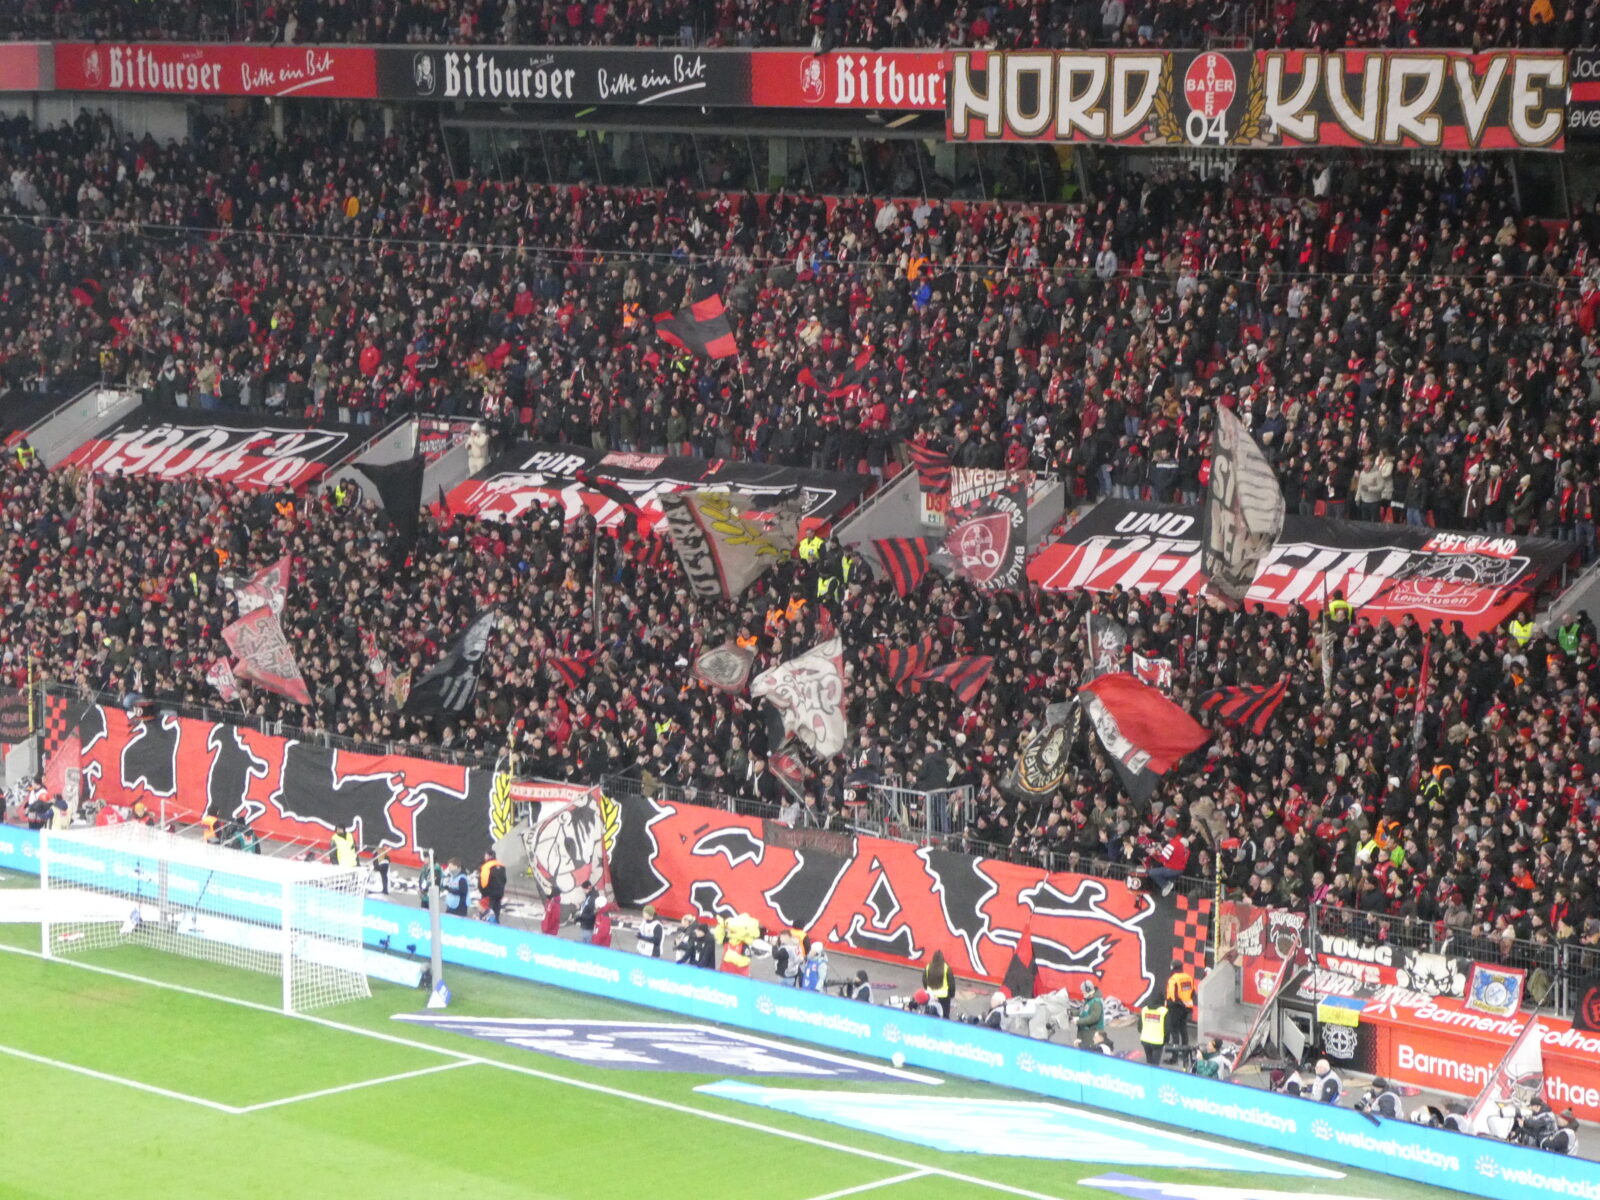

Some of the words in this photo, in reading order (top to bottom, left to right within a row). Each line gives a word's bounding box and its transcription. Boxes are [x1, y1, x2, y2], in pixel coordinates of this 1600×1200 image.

[108, 46, 222, 92] Bitburger
[240, 61, 274, 92] Bitte
[278, 62, 304, 82] ein
[443, 50, 576, 100] Bitburger
[597, 67, 637, 100] Bitte
[640, 68, 671, 90] ein
[834, 54, 945, 105] Bitbur
[1186, 79, 1233, 92] BAYER
[1206, 55, 1216, 116] BAYER
[953, 54, 1161, 136] NORD
[1264, 54, 1565, 146] KURVE
[1185, 109, 1228, 145] 04
[519, 450, 586, 476] FÜR
[1114, 511, 1195, 537] UND
[774, 1003, 871, 1038] weloveholidays
[902, 1031, 1004, 1067] weloveholidays
[1036, 1062, 1145, 1099] weloveholidays
[1179, 1095, 1296, 1133] weloveholidays
[1334, 1129, 1459, 1171] weloveholidays
